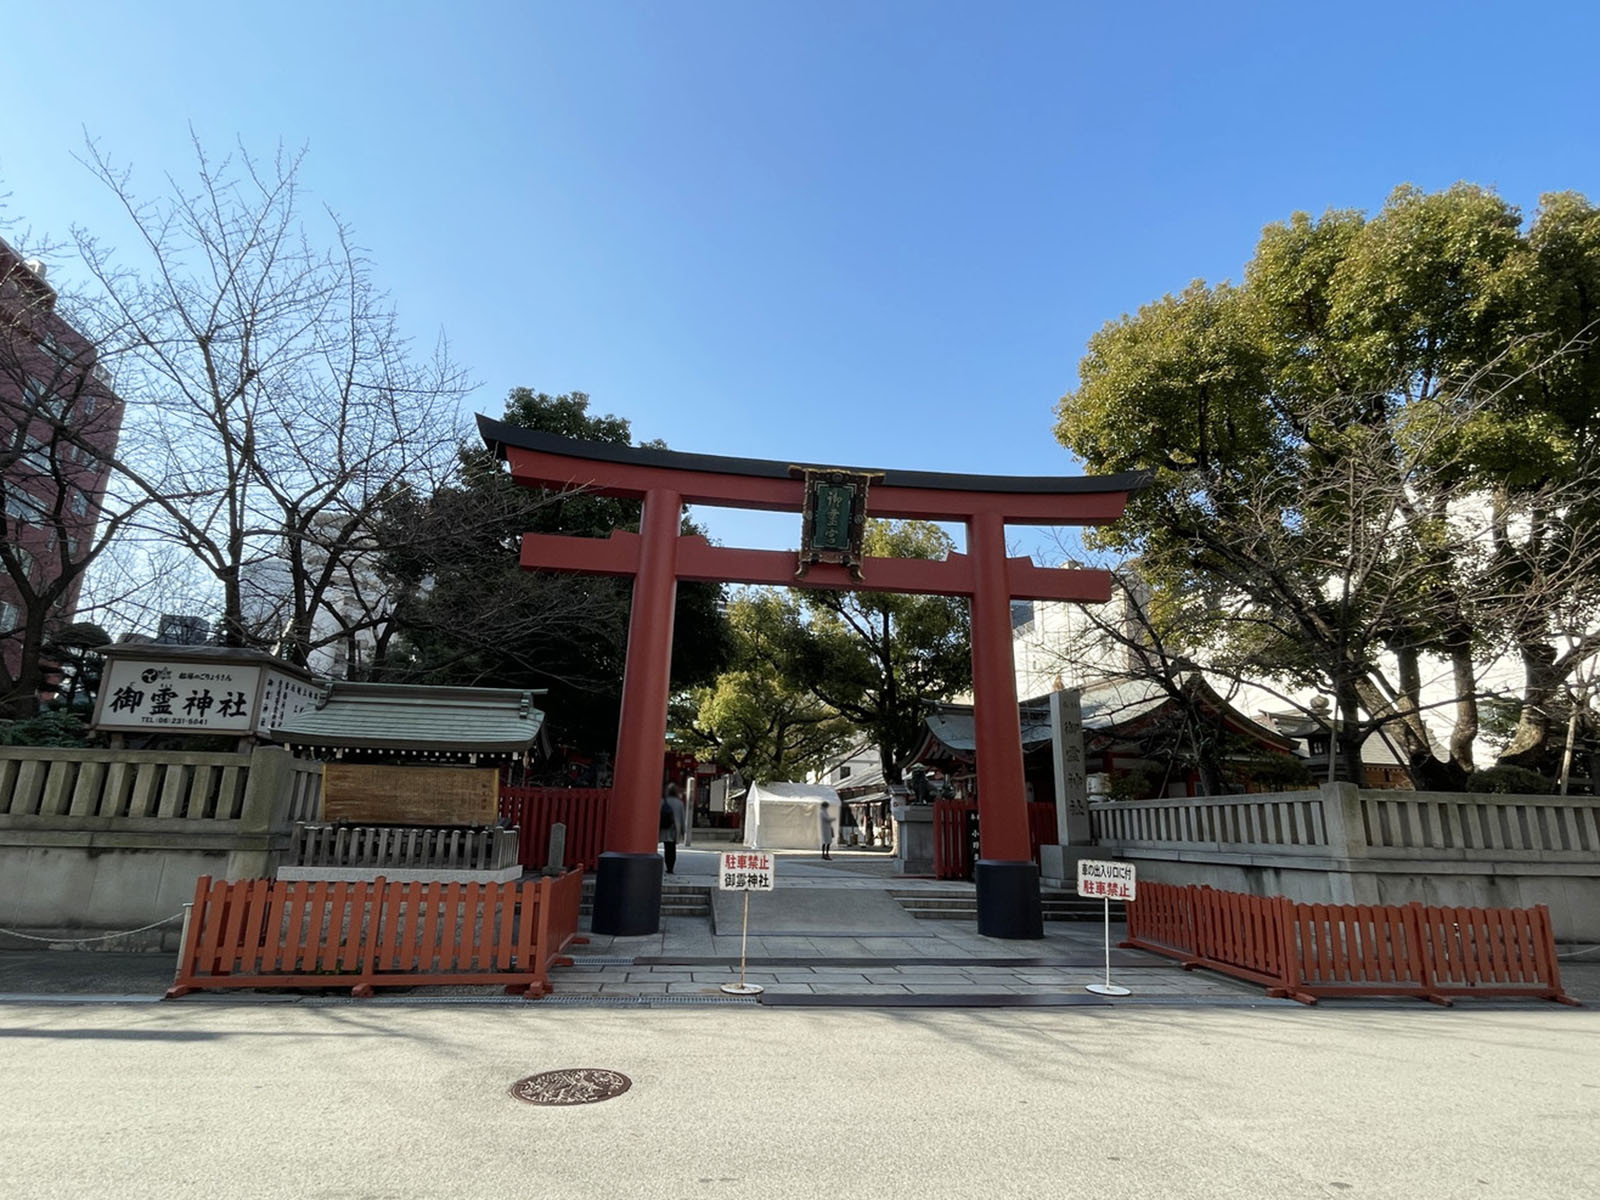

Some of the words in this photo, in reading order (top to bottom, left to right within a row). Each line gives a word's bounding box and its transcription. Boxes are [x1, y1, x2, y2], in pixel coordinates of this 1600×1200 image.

[109, 686, 248, 718] 御霊神社
[725, 854, 769, 869] 駐車禁止
[725, 873, 769, 887] 御霊神社
[1082, 863, 1131, 880] 車の出入り口に付
[1083, 880, 1131, 897] 駐車禁止
